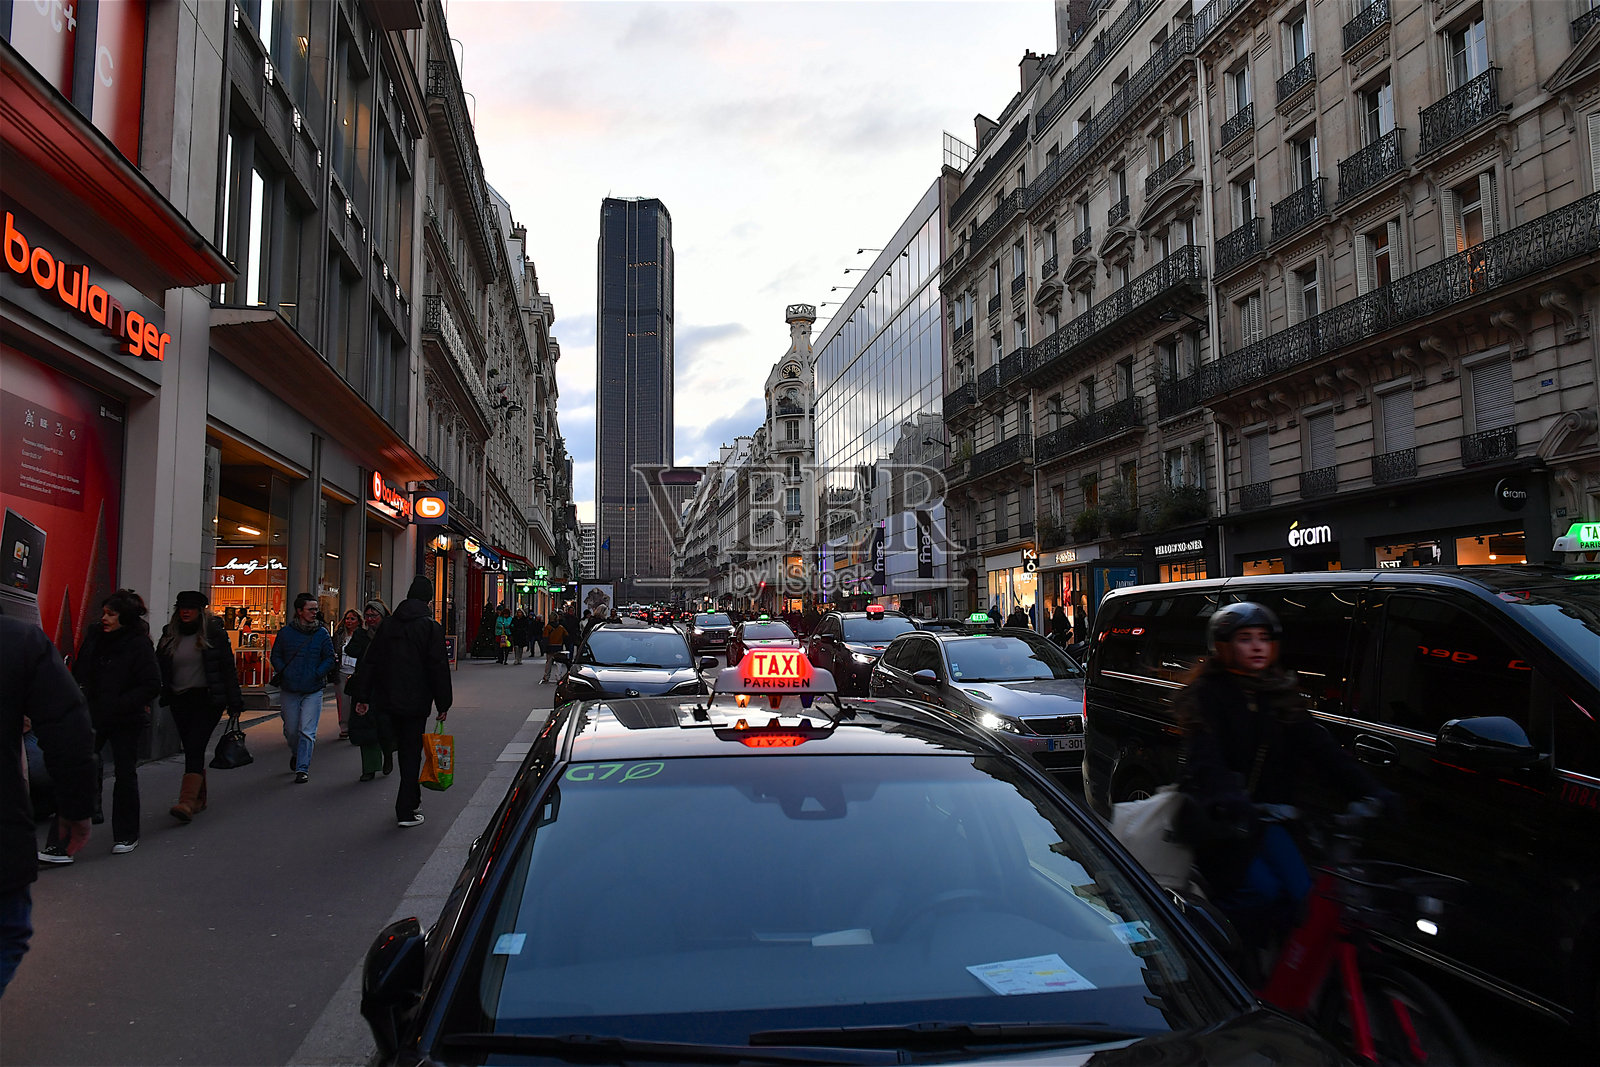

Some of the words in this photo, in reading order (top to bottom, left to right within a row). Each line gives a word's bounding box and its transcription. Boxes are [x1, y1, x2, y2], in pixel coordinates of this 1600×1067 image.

[4, 211, 171, 362] boulanger
[1503, 487, 1527, 499] éram
[1288, 521, 1331, 547] éram
[1585, 526, 1600, 539] TA
[919, 525, 932, 564] fnac
[874, 541, 884, 572] fnac
[754, 654, 800, 676] TAXI
[743, 678, 810, 688] PARISIEN
[565, 763, 625, 782] G7
